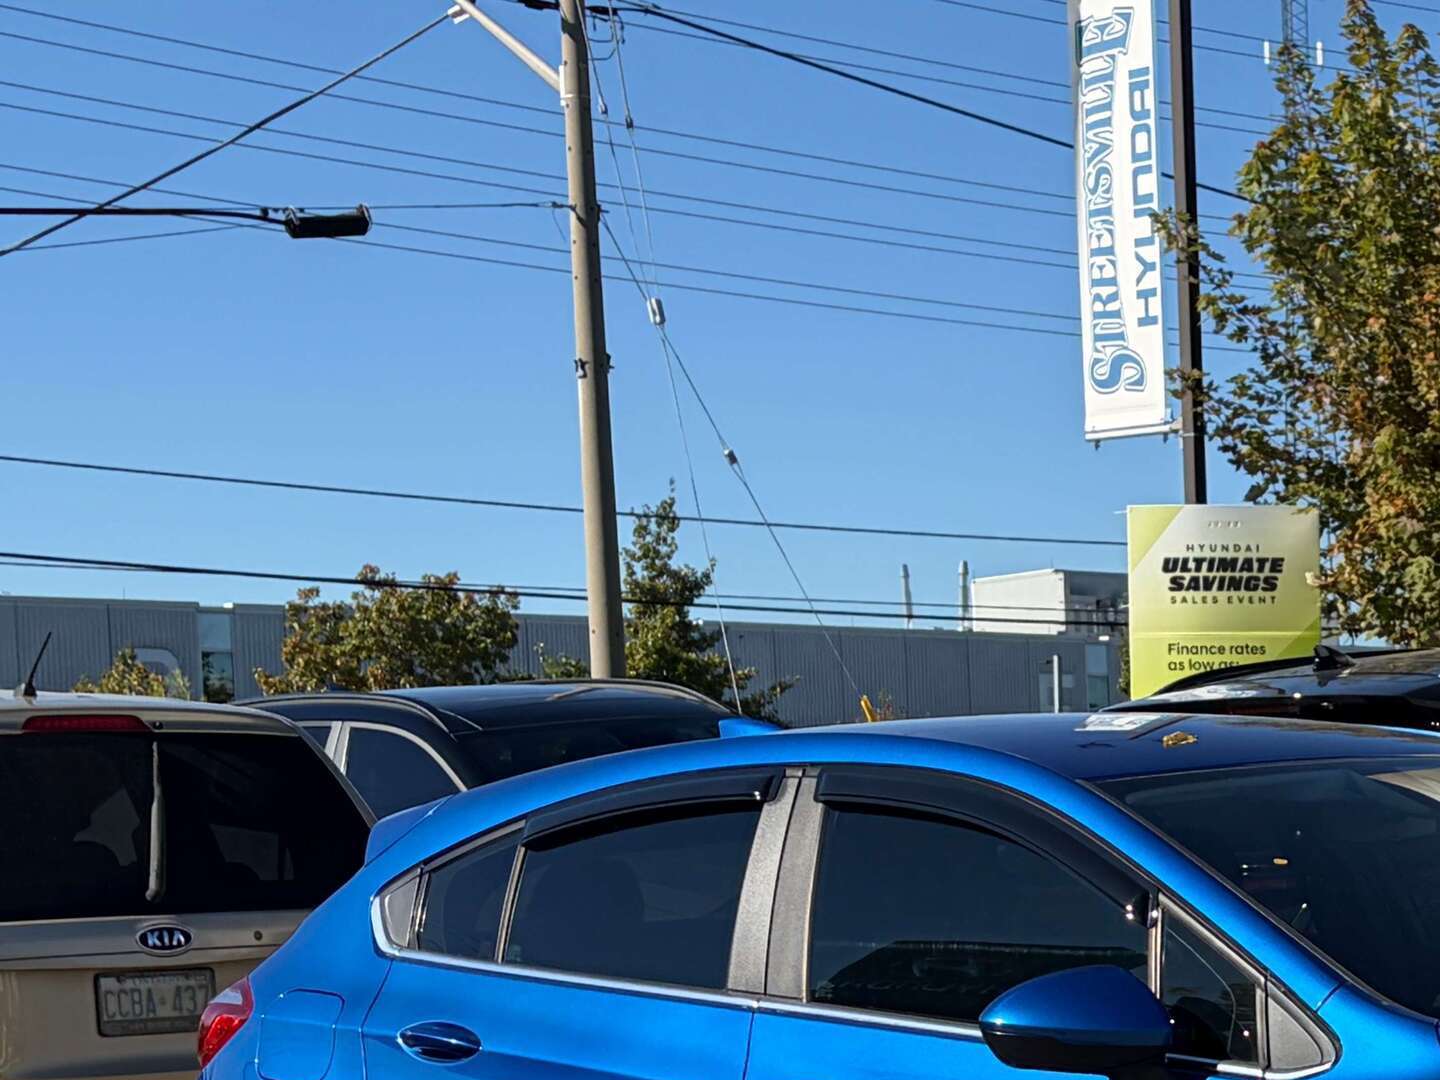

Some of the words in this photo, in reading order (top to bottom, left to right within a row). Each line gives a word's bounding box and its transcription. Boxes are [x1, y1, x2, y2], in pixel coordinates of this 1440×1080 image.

[1076, 7, 1148, 394] STREETSVILLE
[1128, 66, 1158, 328] HYUNDAI
[1185, 543, 1261, 554] HYUNDAI
[1162, 557, 1285, 574] ULTIMATE
[1168, 575, 1279, 592] SAVINGS
[1171, 596, 1219, 605] SALES
[1227, 596, 1277, 605] EVENT
[1168, 642, 1227, 656] Finance
[1229, 643, 1267, 656] rates
[1168, 661, 1186, 672] as
[1188, 658, 1216, 671] low
[147, 932, 186, 948] KIA
[104, 987, 157, 1019] CCBA
